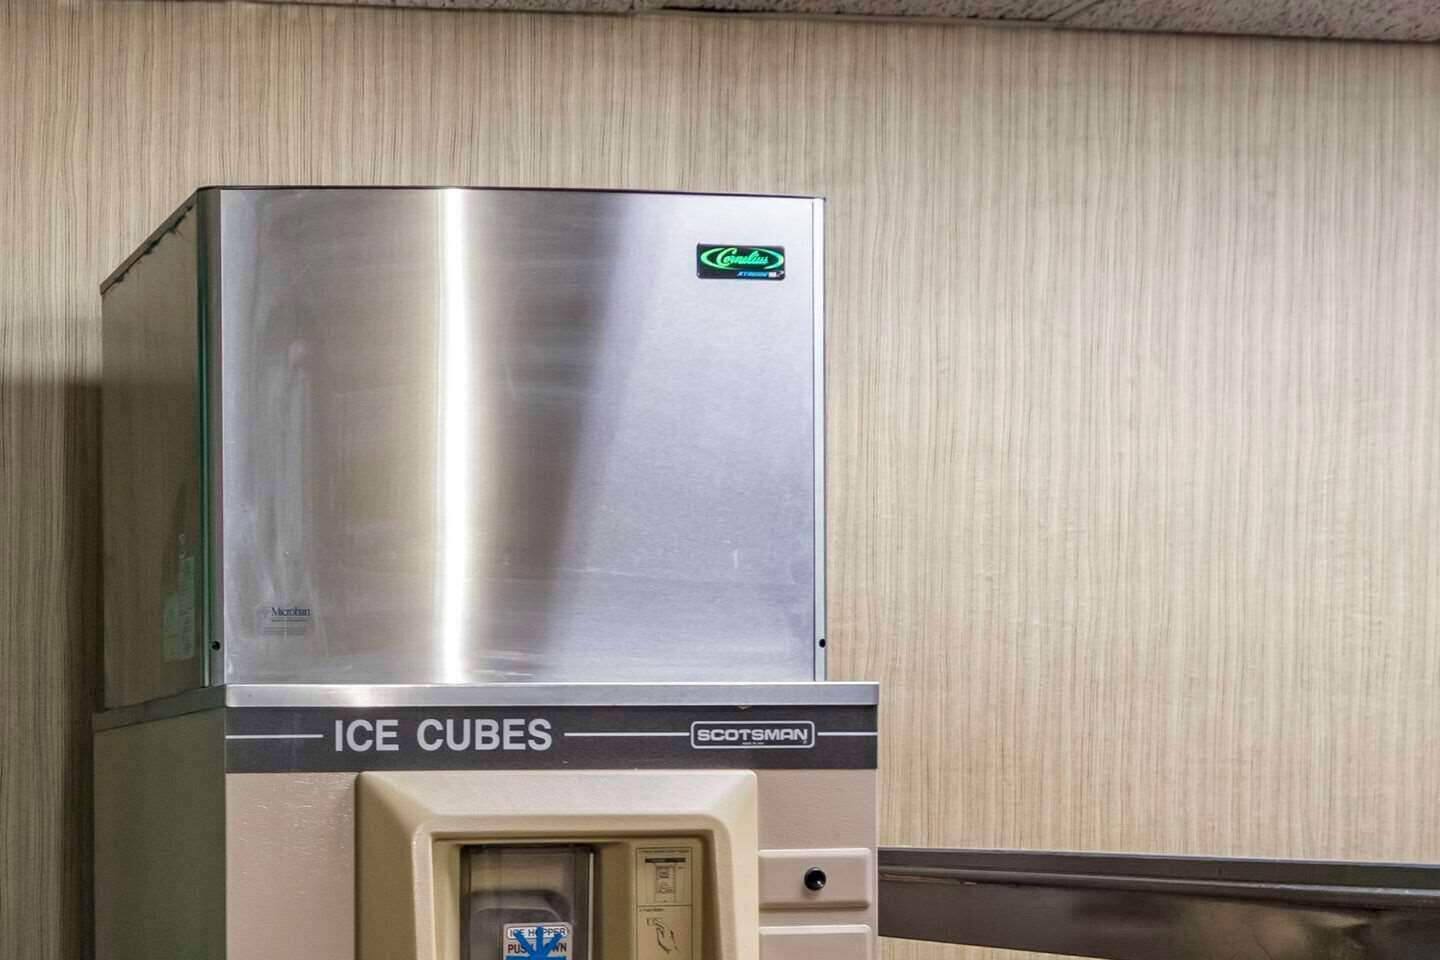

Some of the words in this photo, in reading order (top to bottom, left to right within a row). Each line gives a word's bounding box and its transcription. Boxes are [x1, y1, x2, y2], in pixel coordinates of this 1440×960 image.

[716, 247, 769, 267] Cornelius
[335, 719, 399, 752] ICE
[416, 718, 553, 751] CUBES
[697, 728, 808, 741] SCOTSMAN
[527, 928, 566, 937] HPPER
